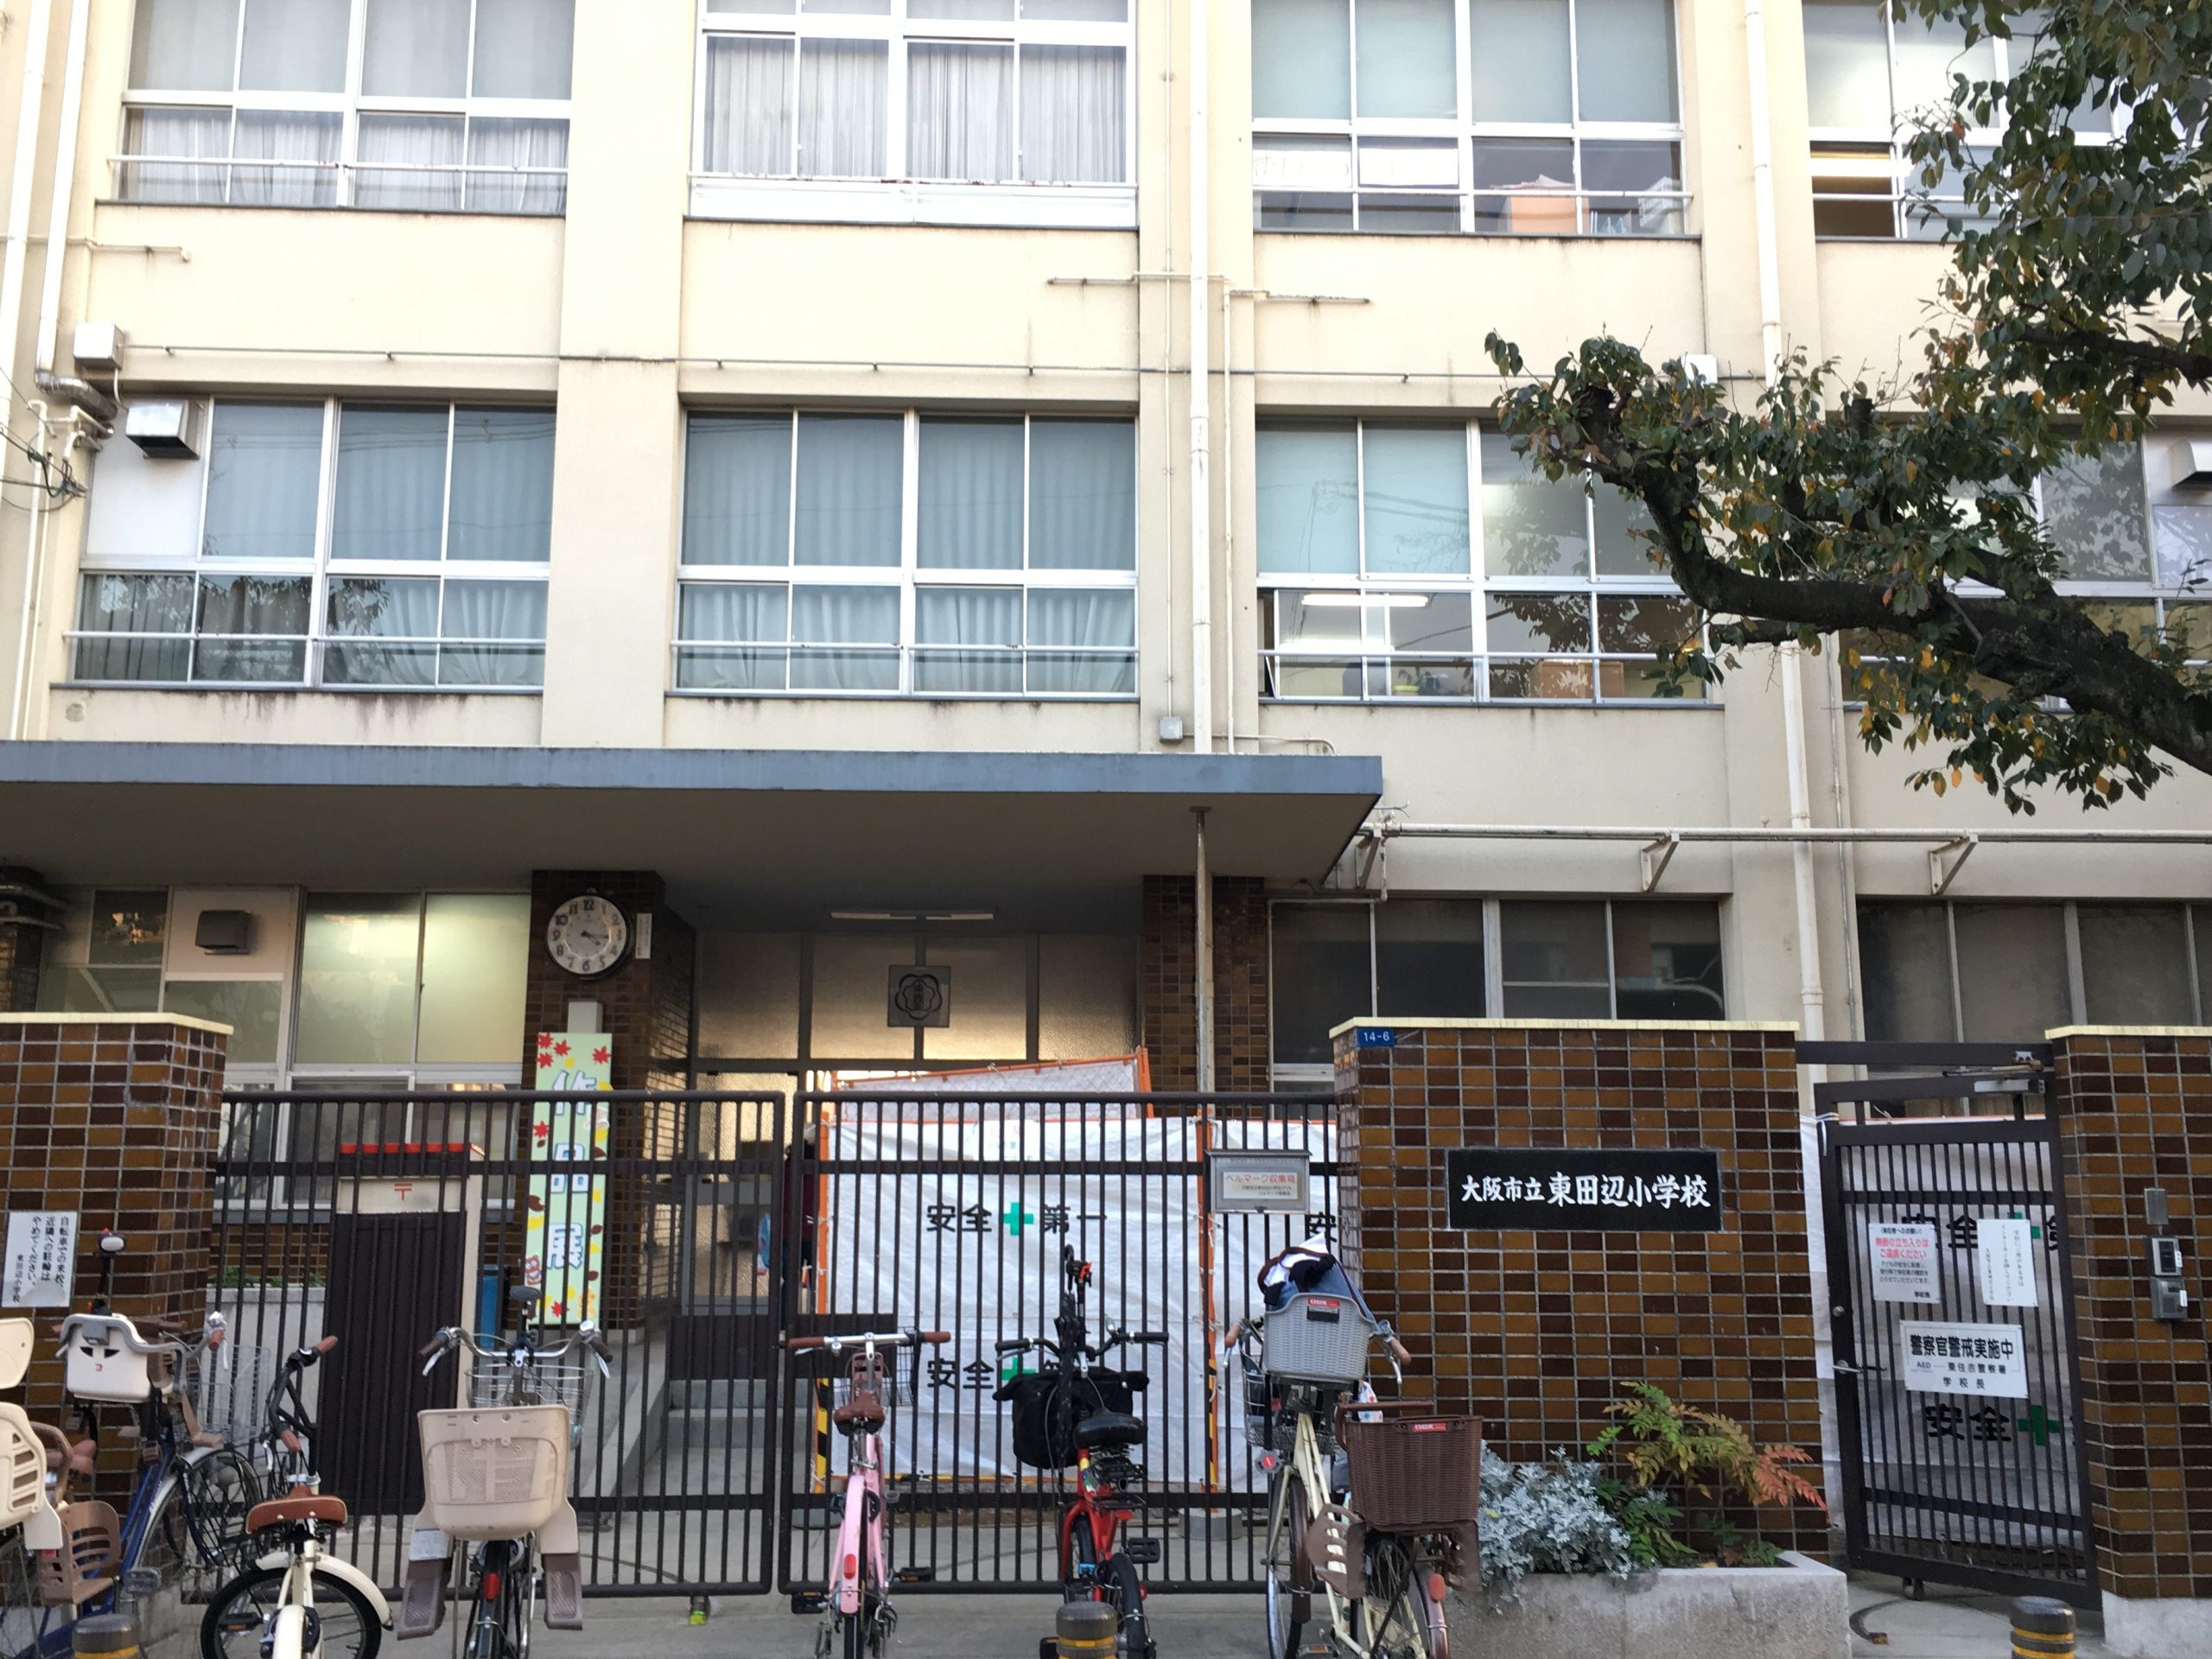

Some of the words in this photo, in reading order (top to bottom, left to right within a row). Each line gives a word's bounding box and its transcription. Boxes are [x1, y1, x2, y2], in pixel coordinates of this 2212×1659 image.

[583, 899, 595, 911] 12
[612, 913, 620, 925] 2
[553, 929, 561, 941] 9
[556, 944, 563, 957] 8
[567, 956, 575, 968] 7
[582, 958, 590, 971] 6
[1363, 1031, 1390, 1042] 14-6
[1461, 1171, 1711, 1209] 大阪市立東田辺小学校
[927, 1203, 992, 1232] 安全
[1910, 1334, 2014, 1360] 警察官警戒実施中
[927, 1358, 994, 1389] 安全
[1926, 1403, 2012, 1441] 安全
